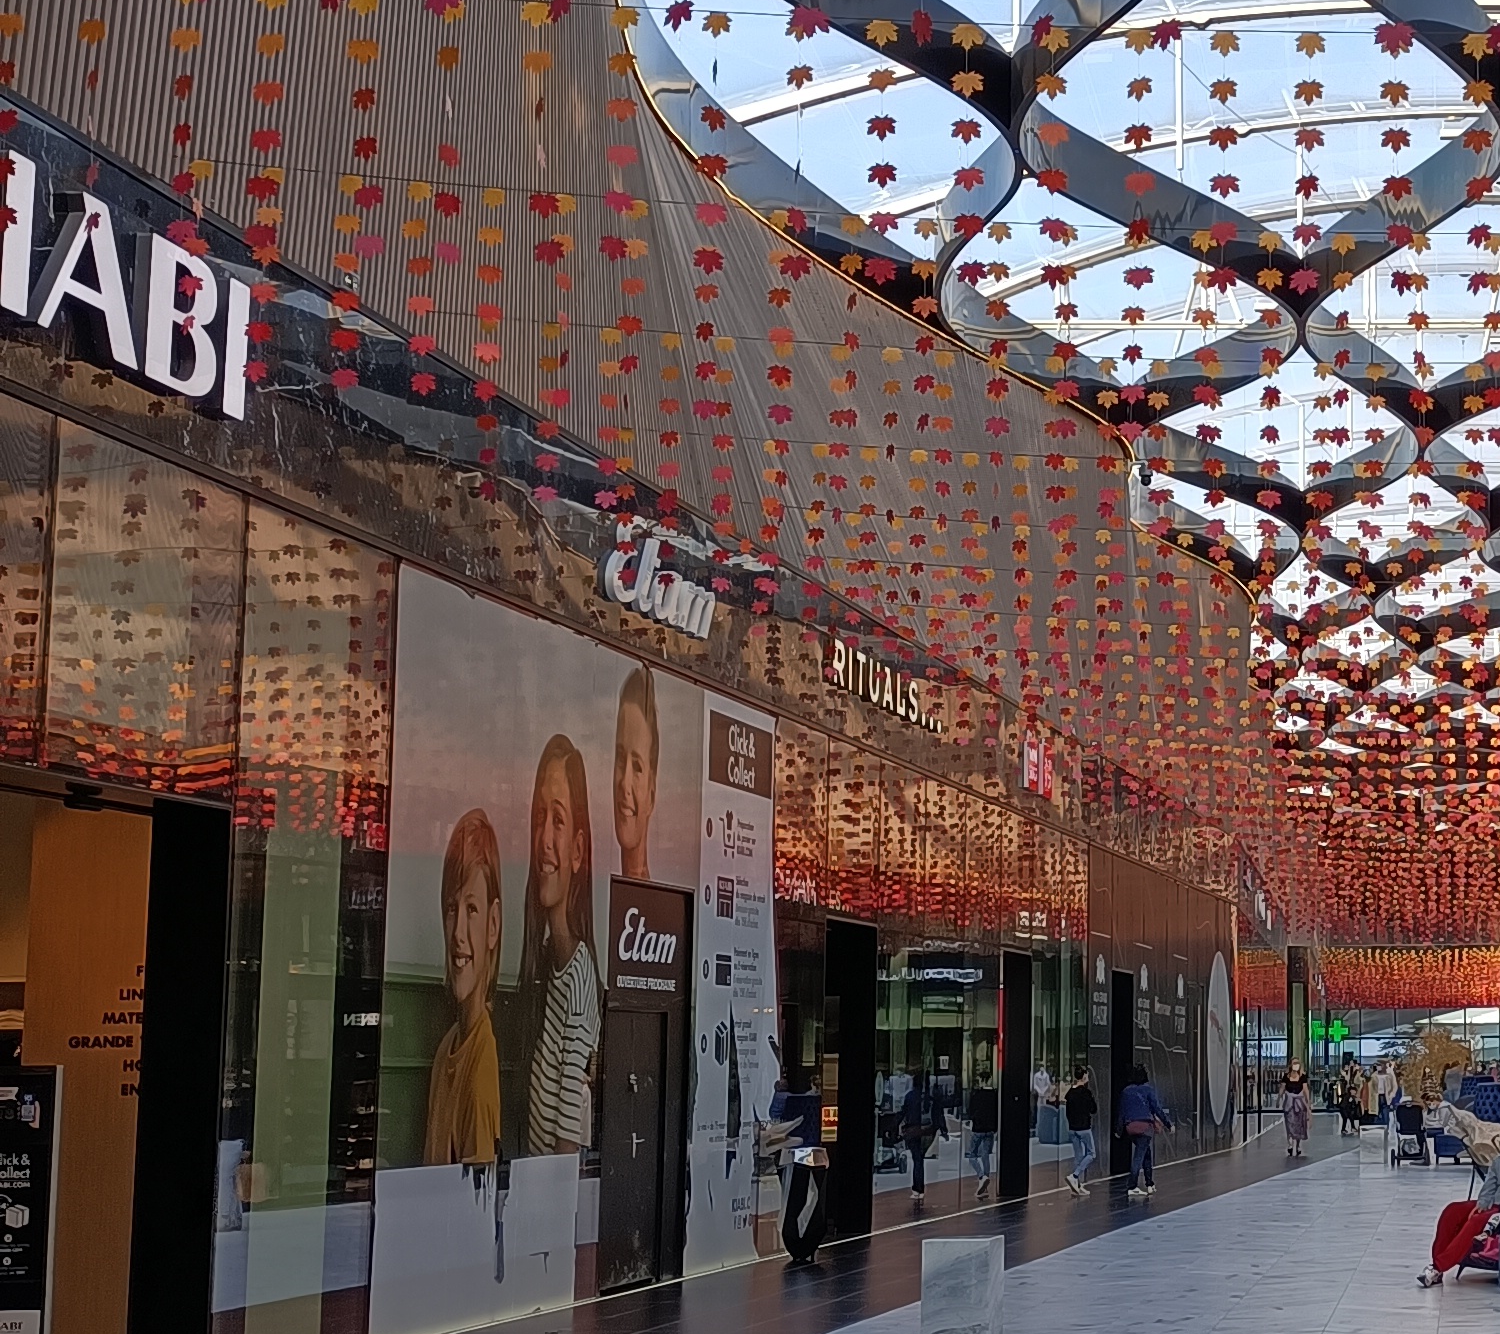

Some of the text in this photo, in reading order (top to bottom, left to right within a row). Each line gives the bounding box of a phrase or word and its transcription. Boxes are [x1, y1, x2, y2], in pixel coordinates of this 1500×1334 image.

[727, 755, 755, 789] Collect
[618, 907, 677, 964] Etam
[68, 1035, 134, 1048] GRANDE
